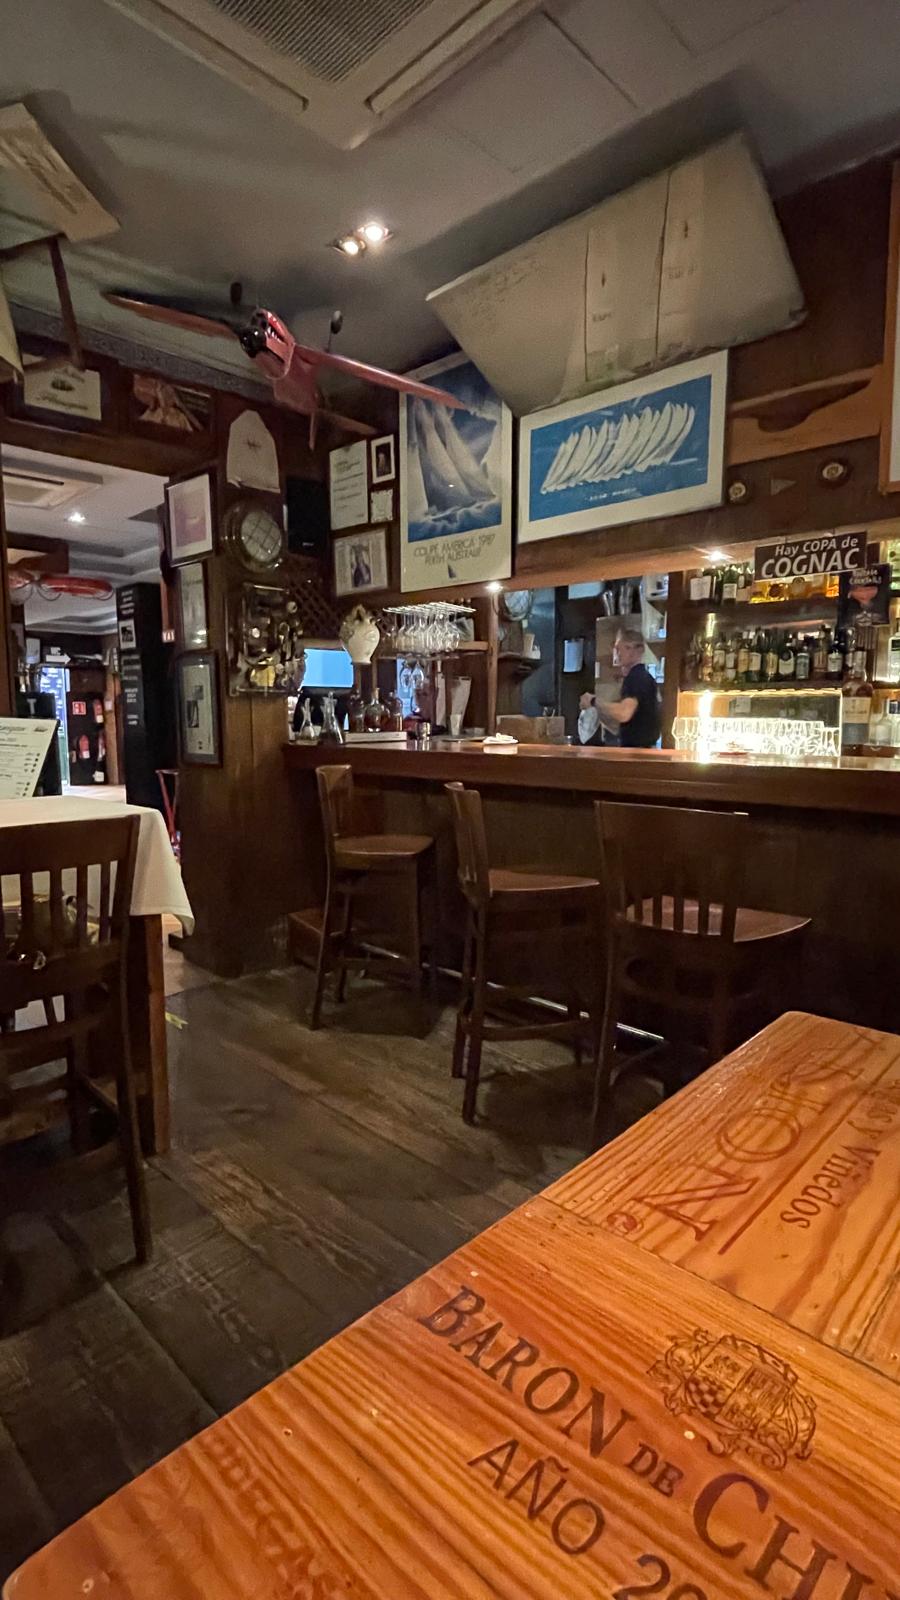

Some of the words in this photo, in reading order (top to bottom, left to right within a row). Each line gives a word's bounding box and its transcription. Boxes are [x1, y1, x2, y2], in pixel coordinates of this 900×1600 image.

[761, 548, 860, 579] COGNAC
[775, 544, 799, 558] Hay
[802, 538, 837, 553] COPA
[841, 536, 859, 548] de
[779, 1144, 882, 1230] Viñedos
[417, 1285, 637, 1459] BARON
[627, 1442, 684, 1498] DE
[692, 1472, 900, 1600] CHI
[468, 1437, 607, 1556] AÑO
